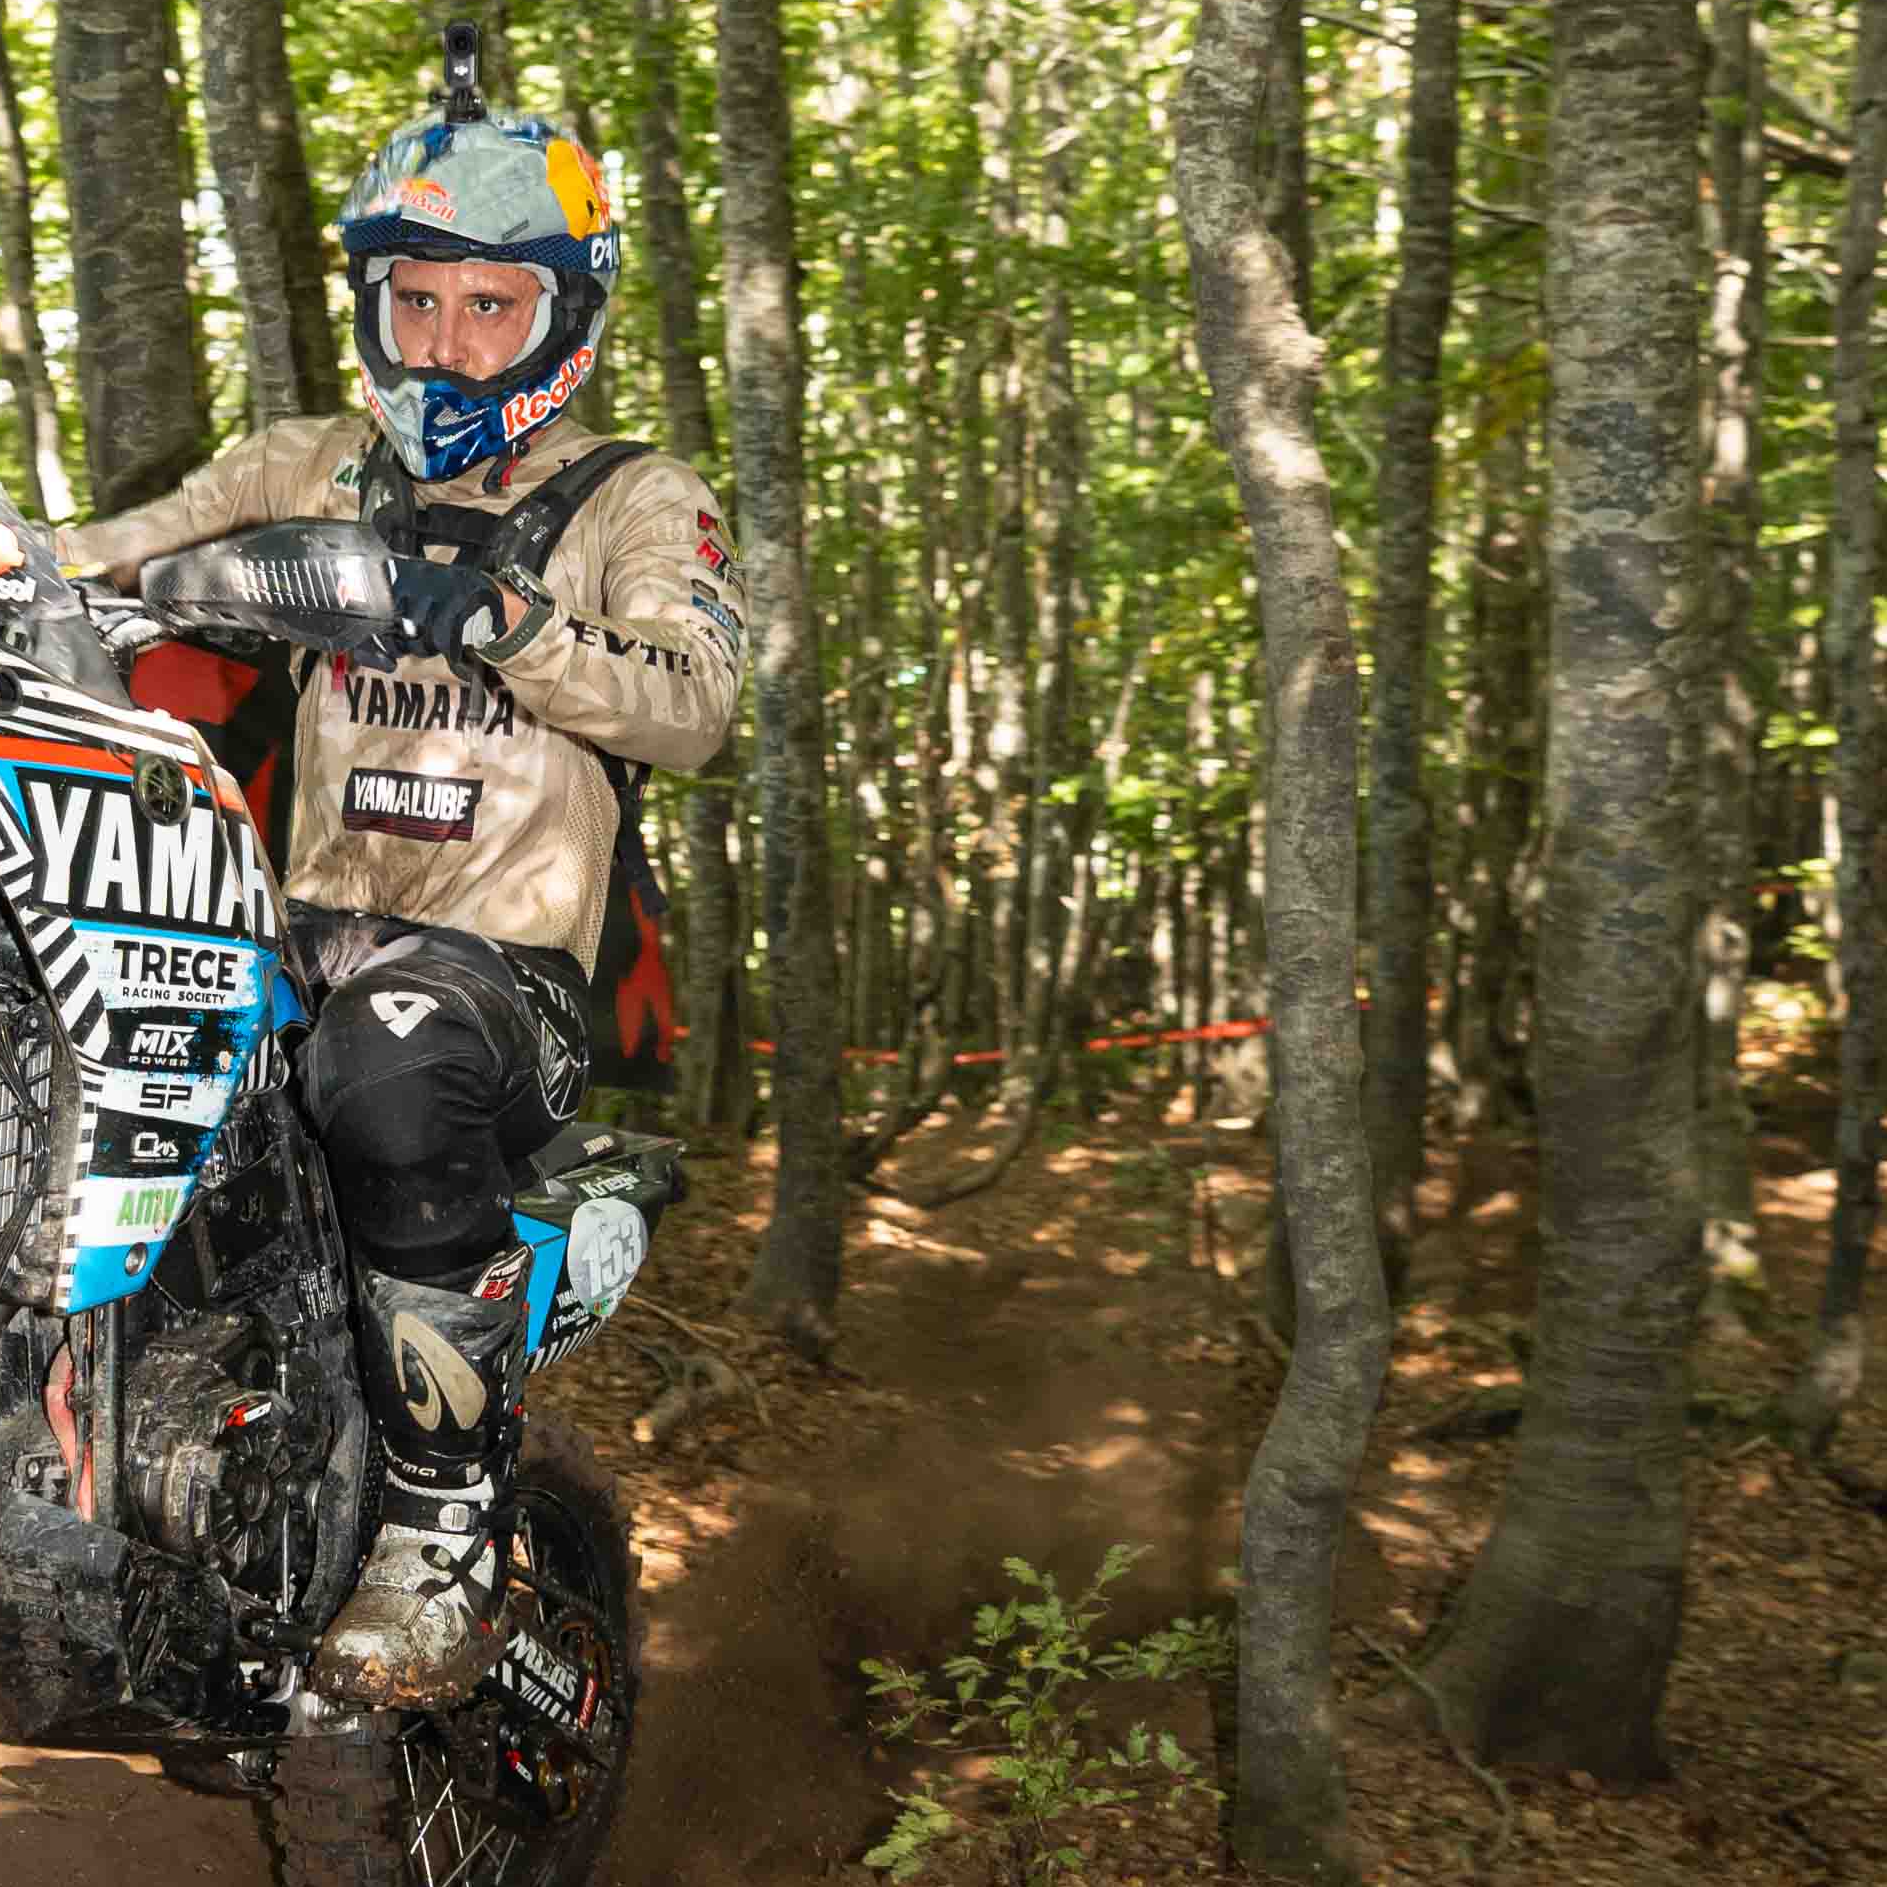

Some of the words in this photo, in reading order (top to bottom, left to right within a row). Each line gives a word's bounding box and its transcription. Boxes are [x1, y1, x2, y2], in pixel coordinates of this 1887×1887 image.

[353, 774, 472, 822] YAMALUBE
[113, 939, 238, 992] TRECE
[122, 986, 171, 1001] RACING
[177, 988, 227, 1005] SOCIETY
[129, 1022, 199, 1058] MTX
[128, 1056, 189, 1067] POWER
[579, 1171, 642, 1199] Kriega
[581, 1212, 643, 1299] 153
